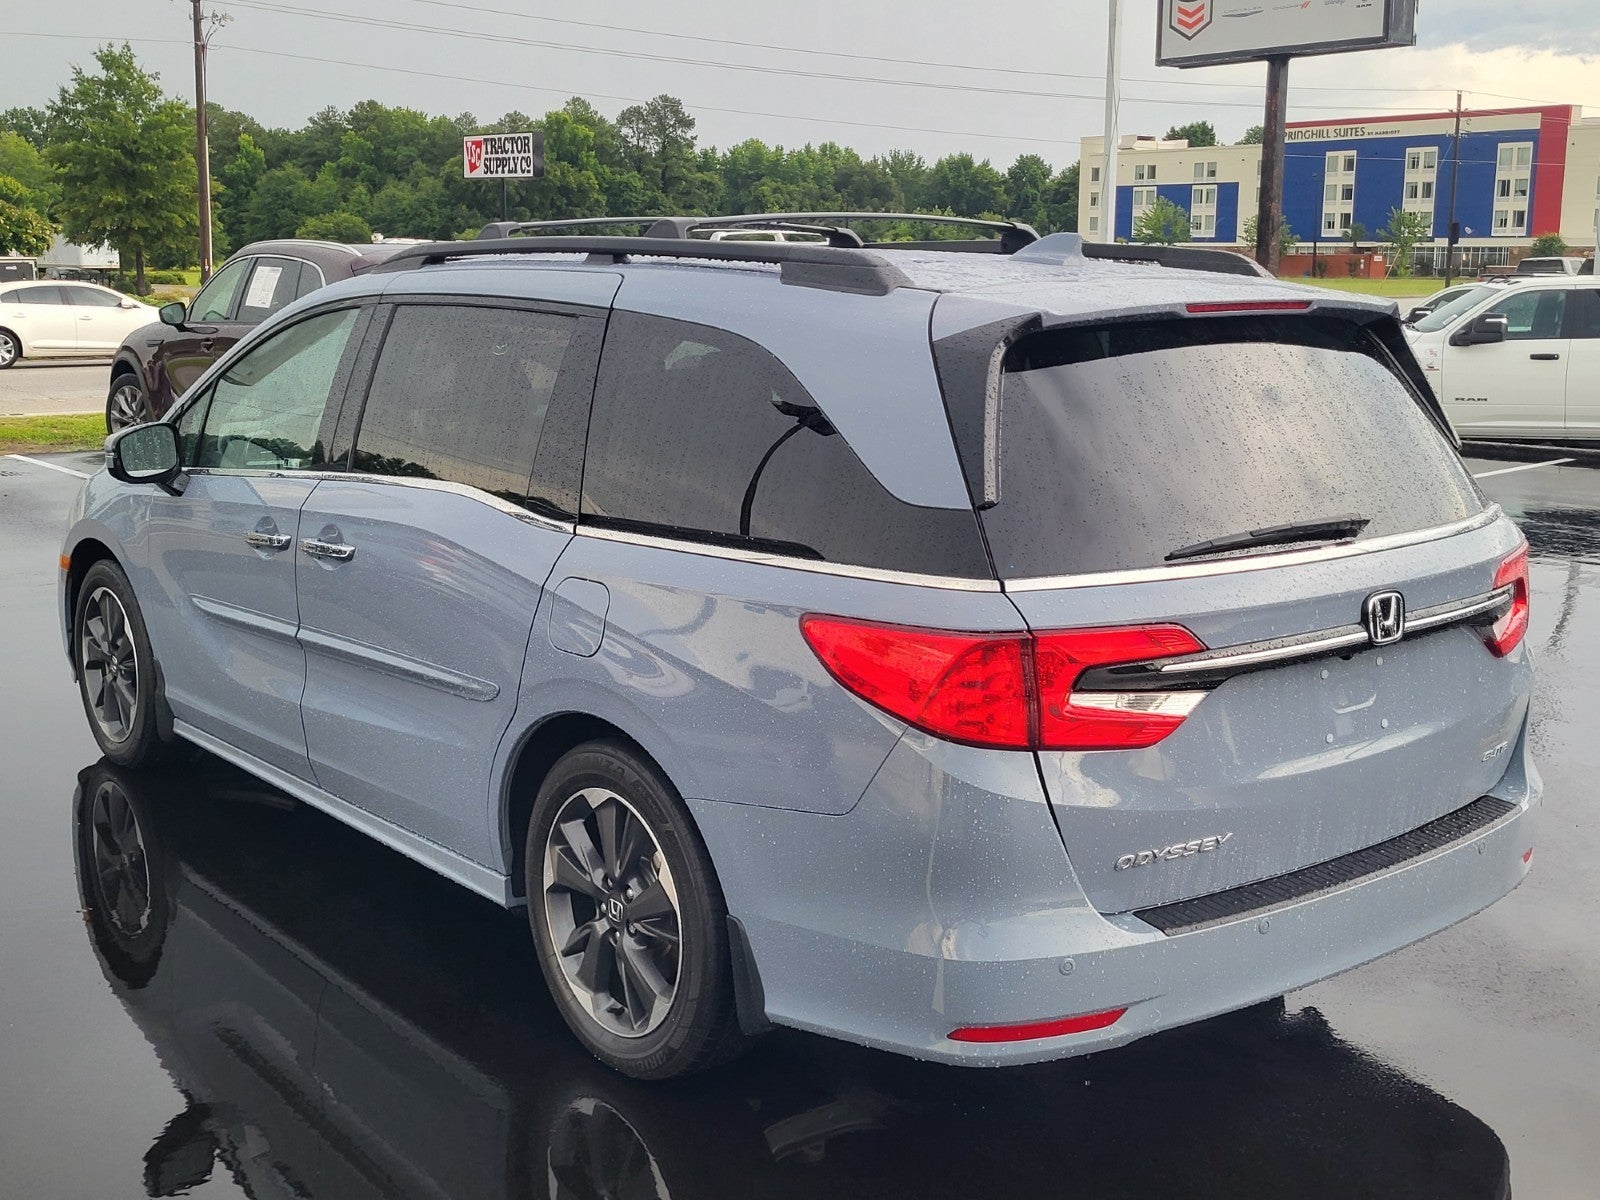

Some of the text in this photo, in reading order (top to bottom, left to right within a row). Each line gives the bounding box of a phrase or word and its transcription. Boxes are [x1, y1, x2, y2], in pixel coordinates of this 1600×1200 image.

[1284, 129, 1331, 141] PRINGHILL
[1333, 127, 1366, 138] SUITES
[467, 141, 480, 166] TSC
[484, 136, 531, 155] TRACTOR
[483, 156, 520, 175] SUPPLY
[1113, 832, 1234, 872] ODYSSEY
